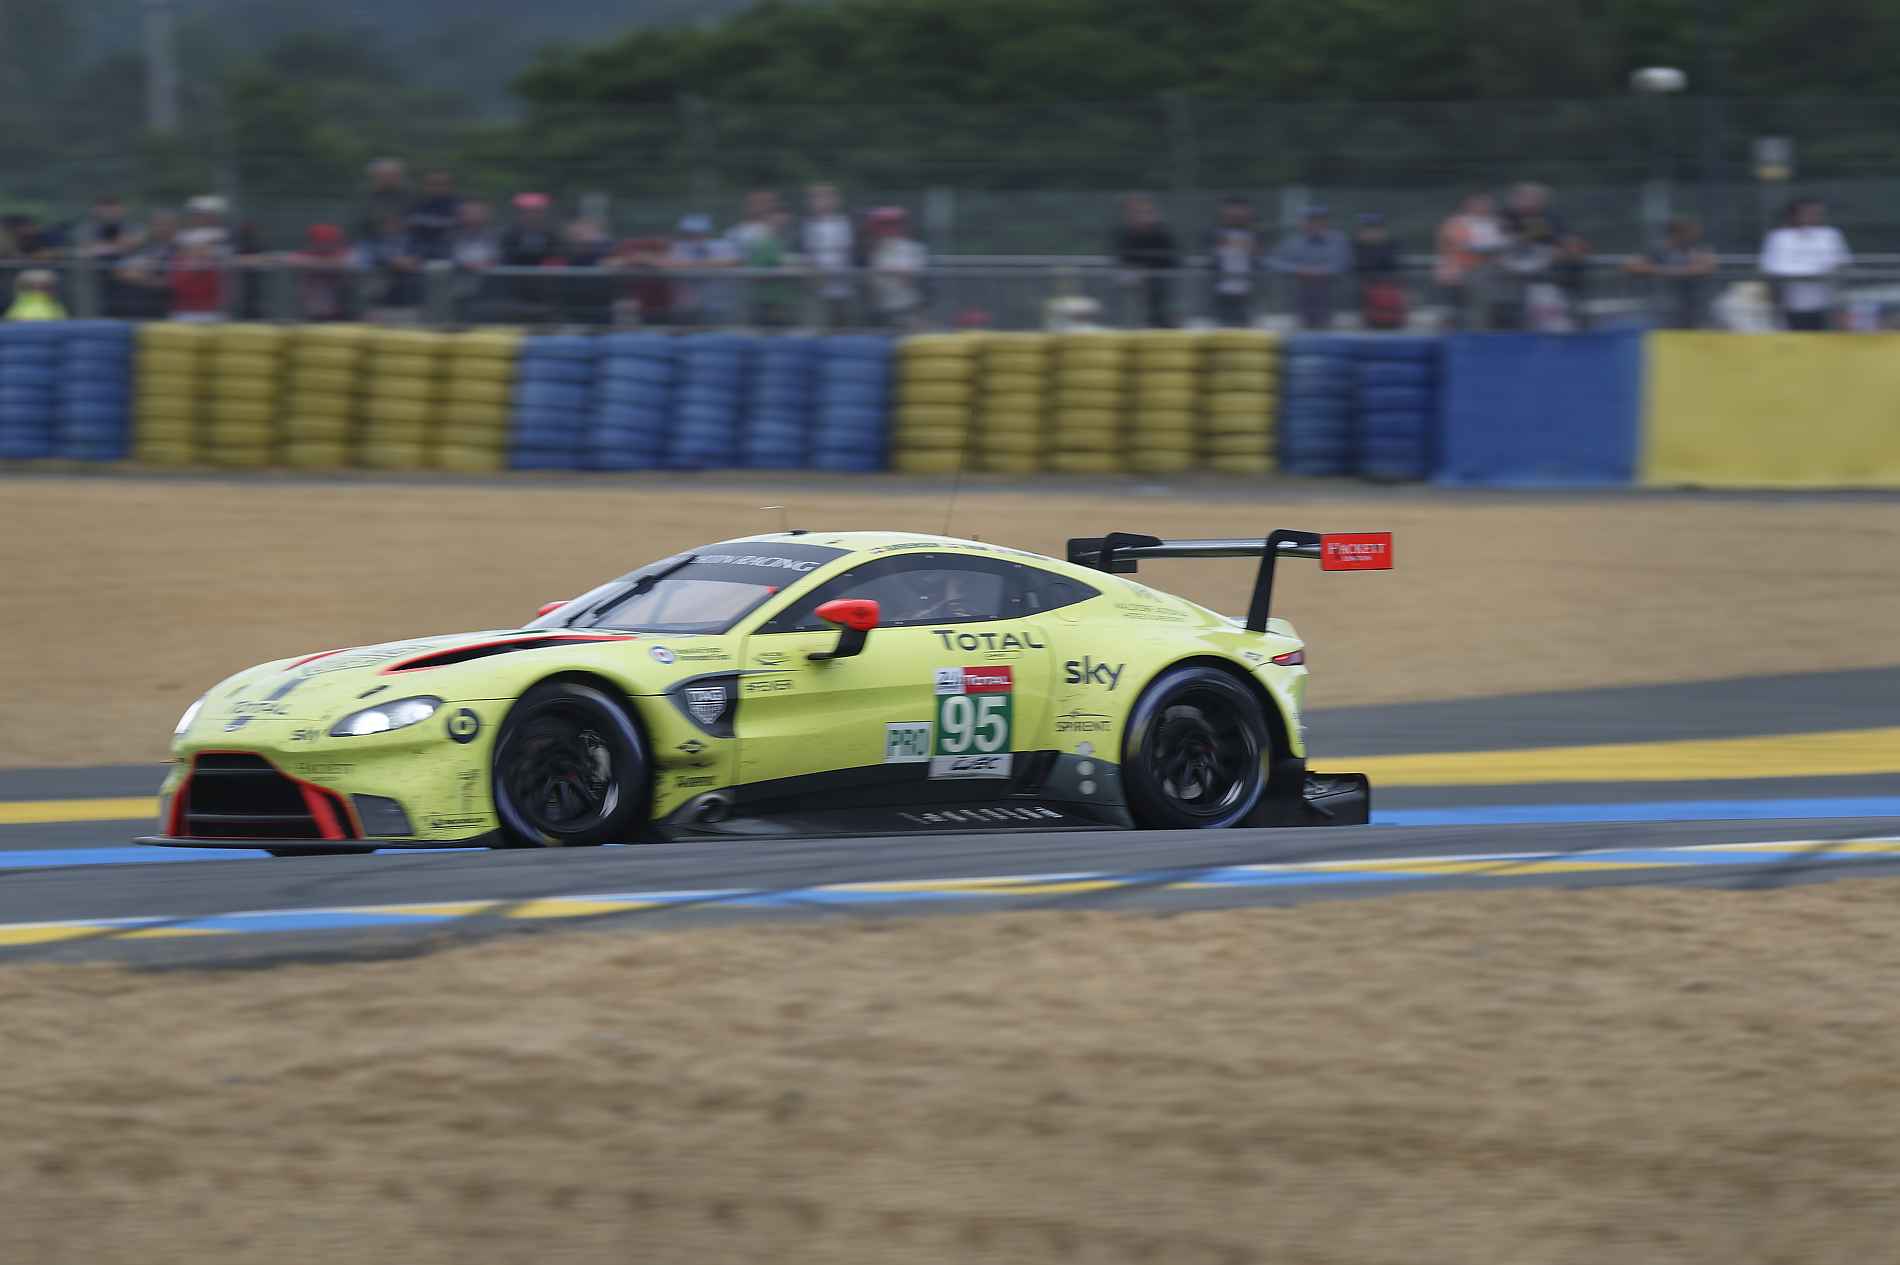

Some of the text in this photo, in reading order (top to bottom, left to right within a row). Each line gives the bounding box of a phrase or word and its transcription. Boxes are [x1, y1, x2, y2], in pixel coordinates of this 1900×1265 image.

[932, 629, 1046, 651] TOTAL
[1064, 656, 1126, 691] sky
[941, 696, 1009, 753] 95
